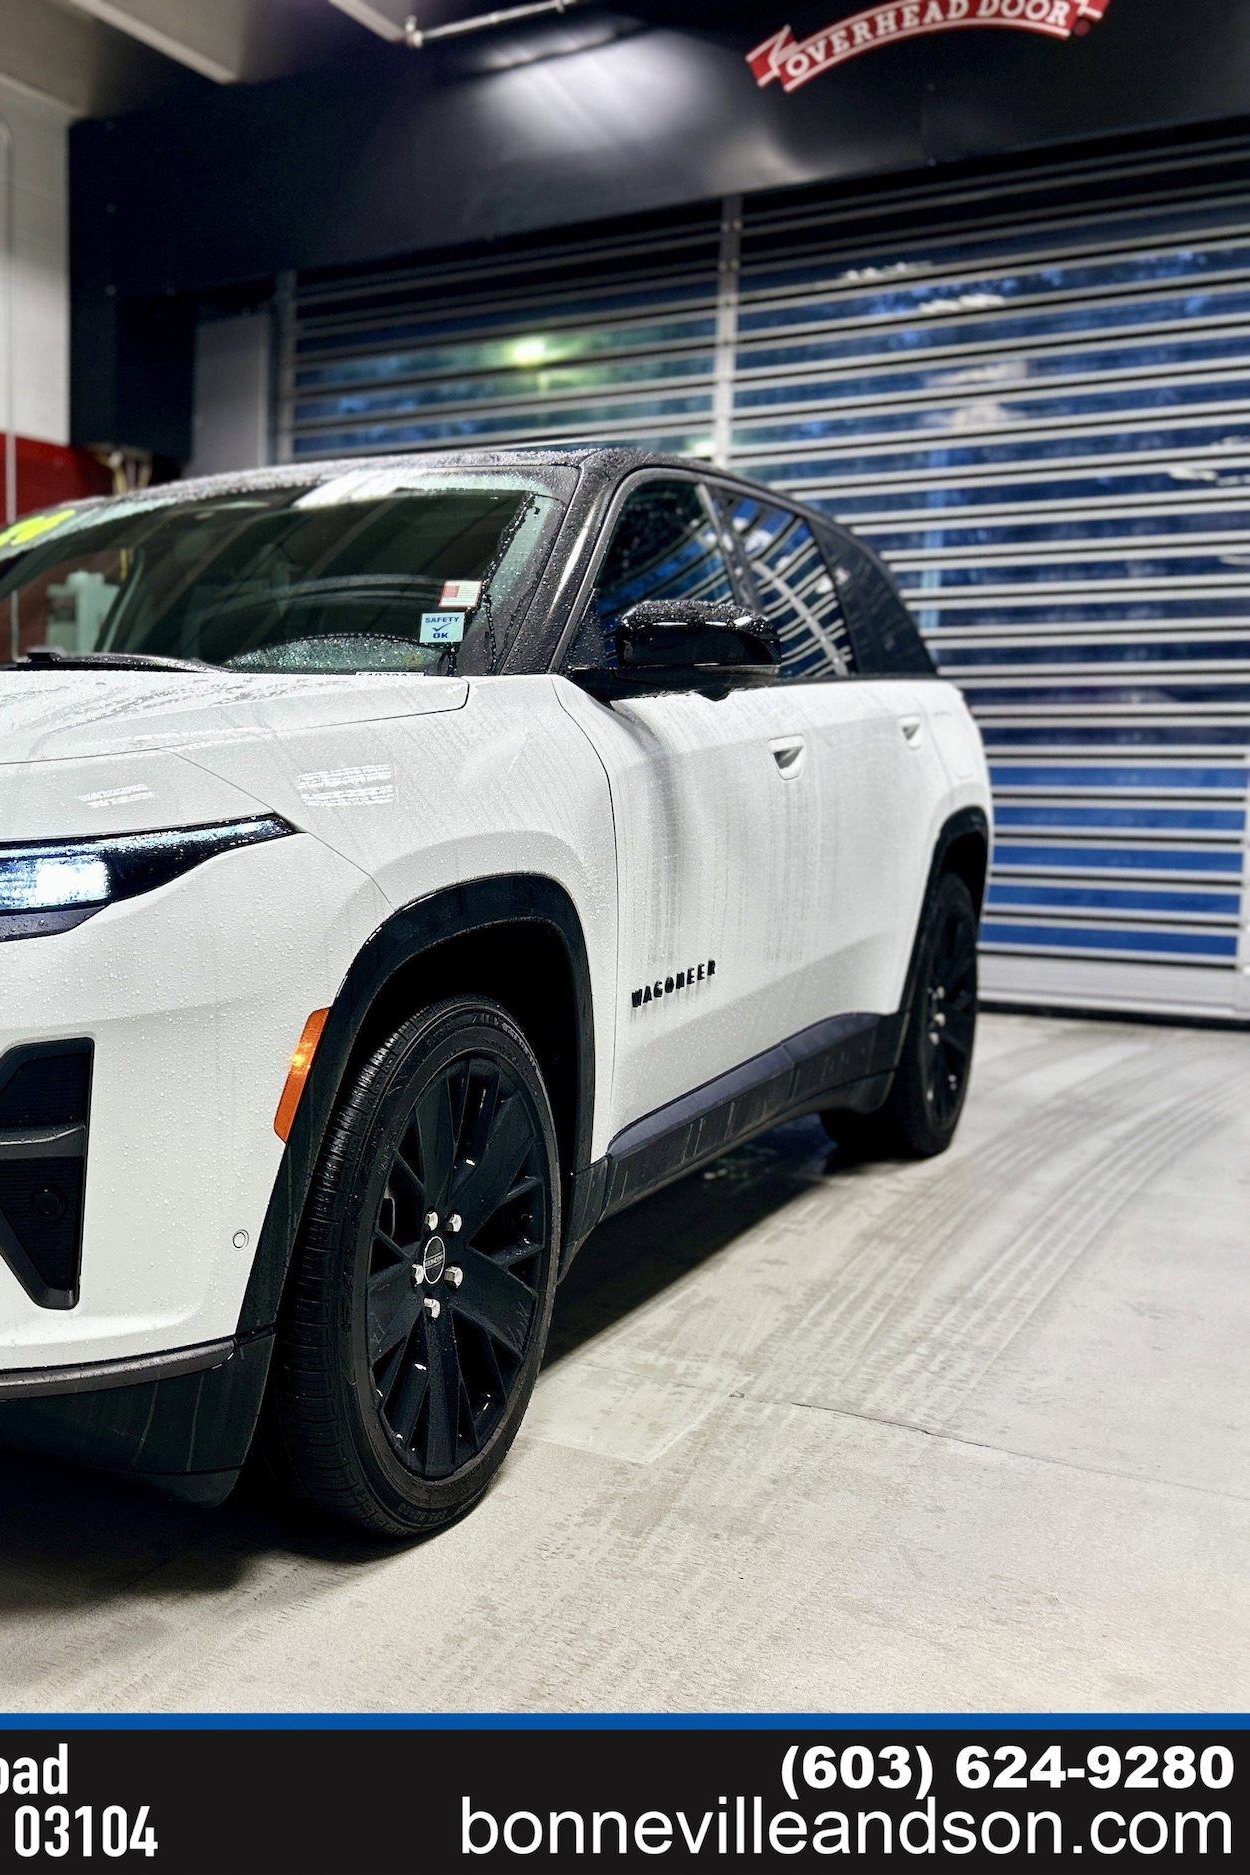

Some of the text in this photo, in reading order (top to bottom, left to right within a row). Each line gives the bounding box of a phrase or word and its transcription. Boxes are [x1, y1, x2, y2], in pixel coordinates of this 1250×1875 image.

[784, 0, 1071, 78] OVERHEAD DOOR
[424, 616, 460, 624] SAFETY
[631, 959, 716, 1008] WAGONEER
